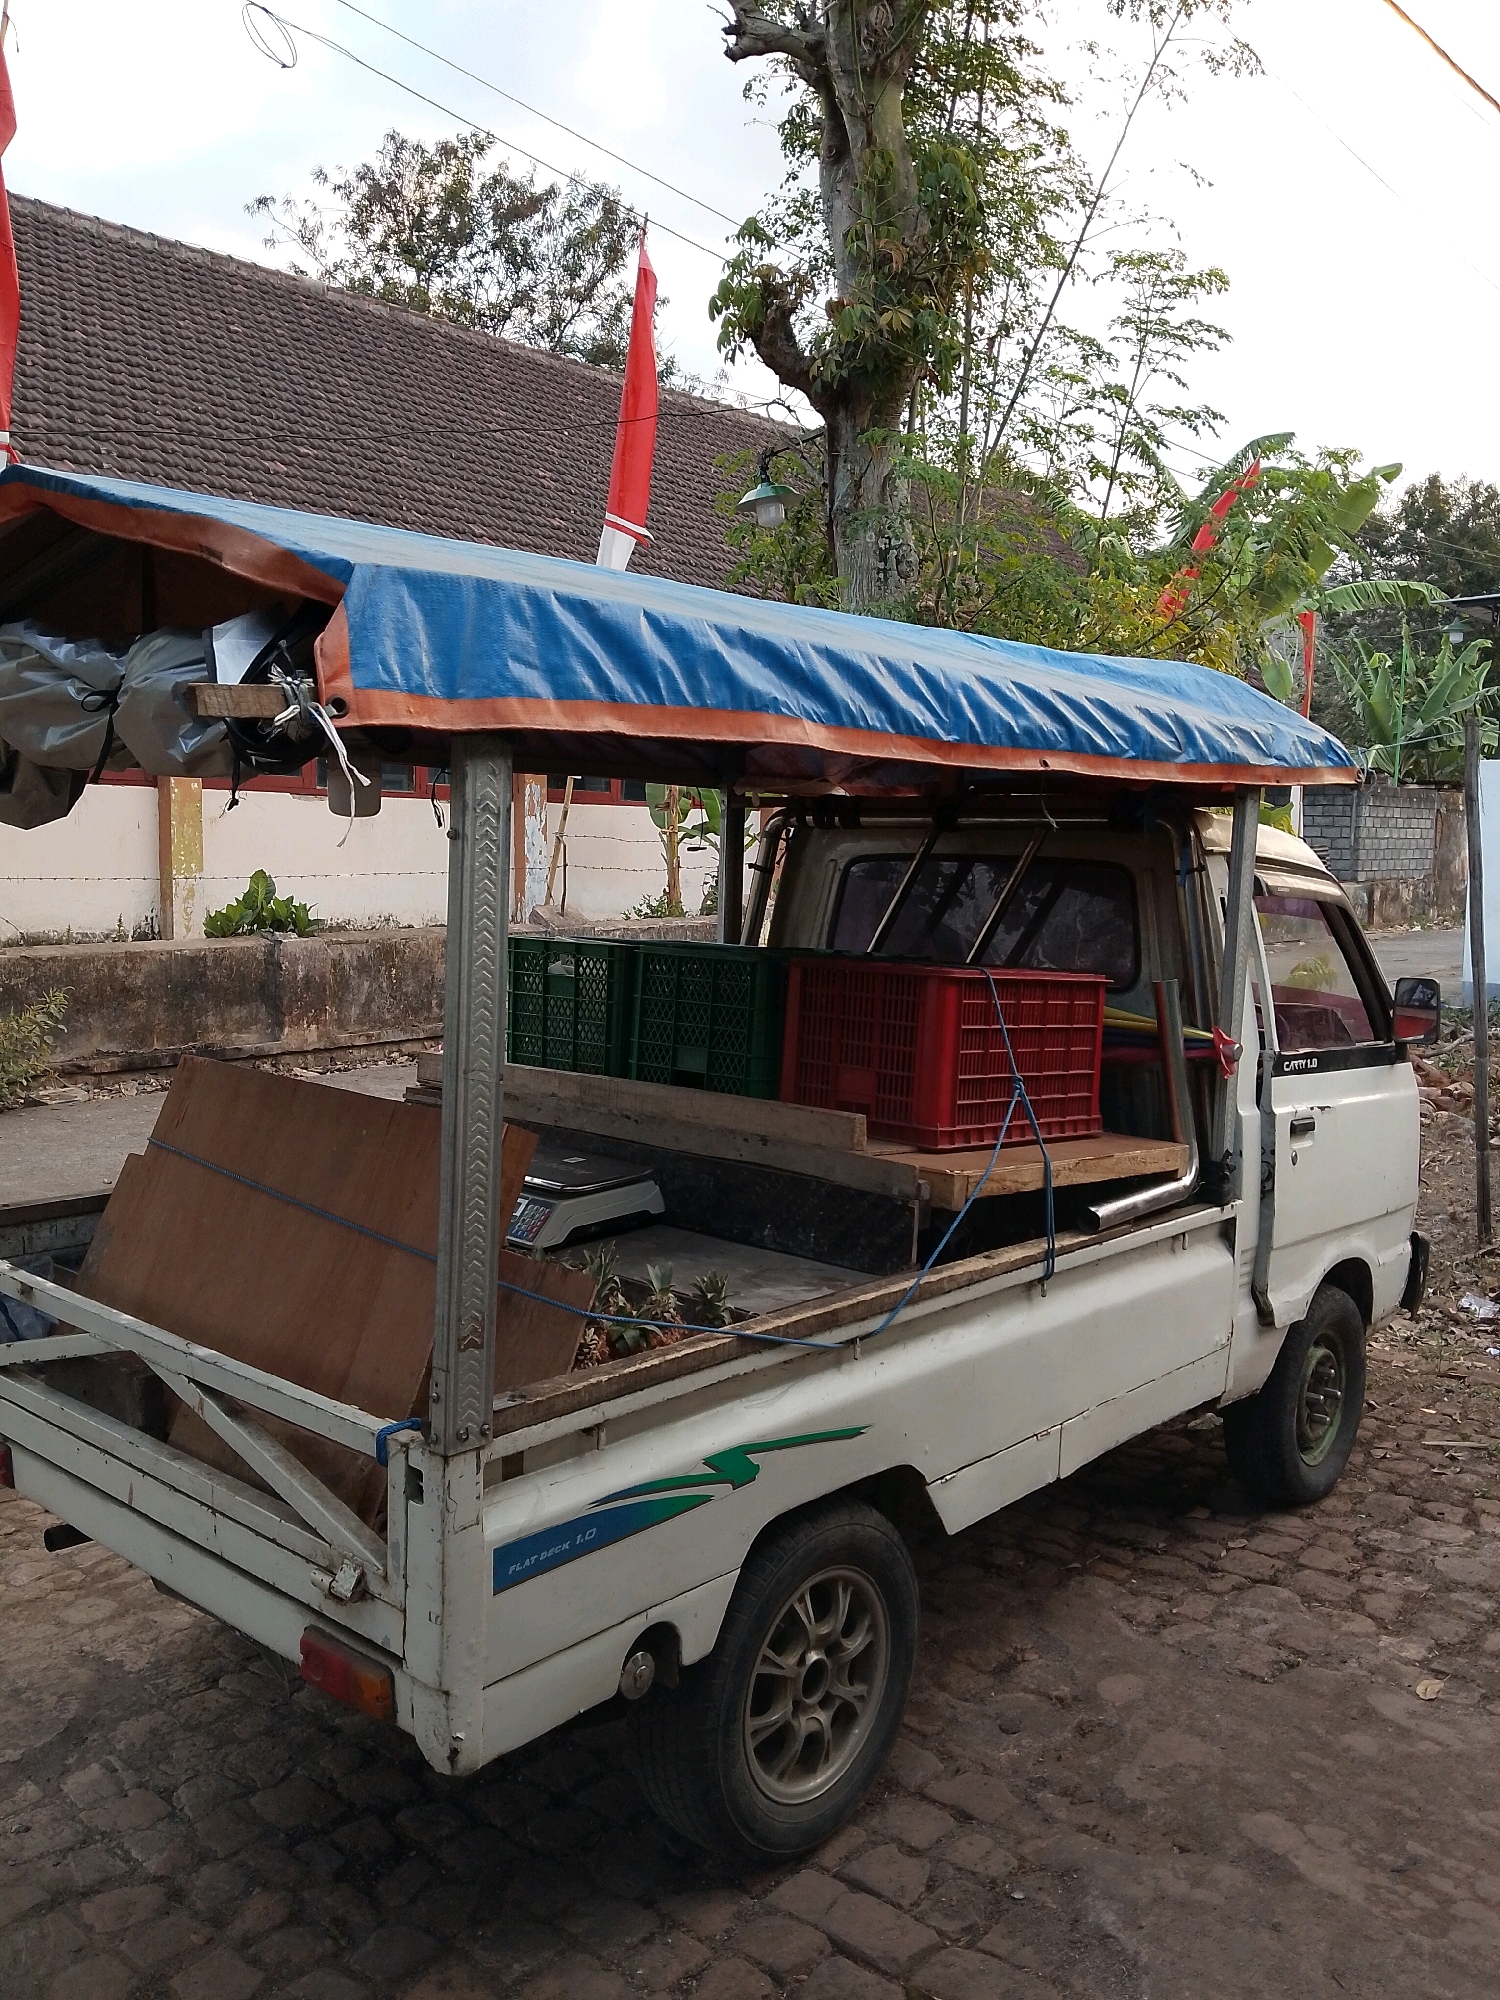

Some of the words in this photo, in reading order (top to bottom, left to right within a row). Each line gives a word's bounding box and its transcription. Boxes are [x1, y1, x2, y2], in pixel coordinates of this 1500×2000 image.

[1283, 1059, 1307, 1072] CARRY
[1307, 1058, 1318, 1069] 1.0
[508, 1555, 538, 1575] FLAT
[539, 1540, 571, 1561] DECK
[575, 1527, 597, 1545] 1.0
